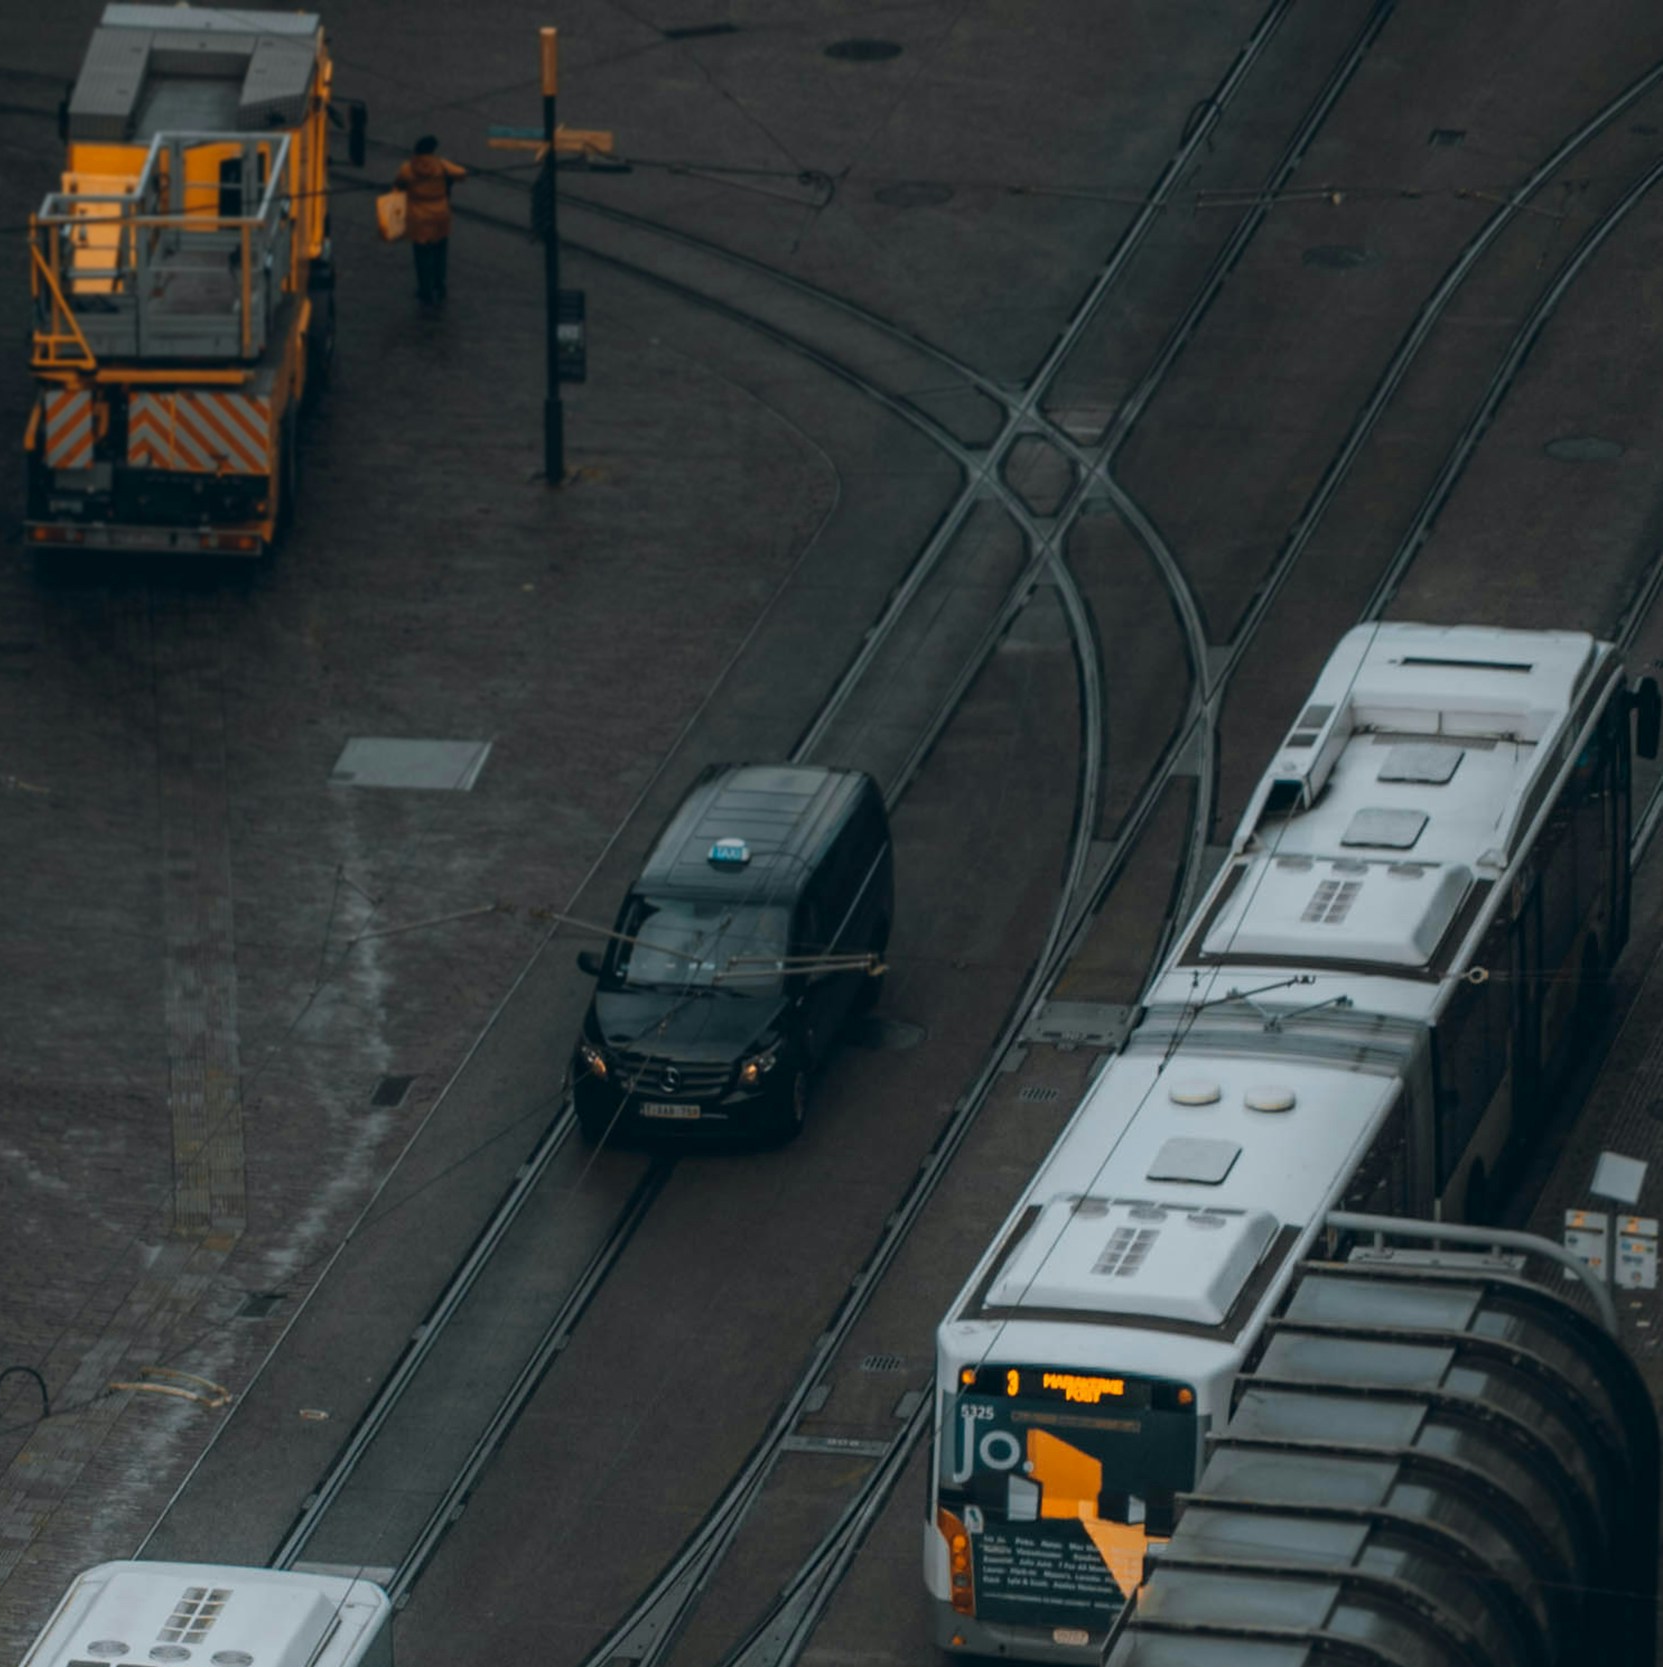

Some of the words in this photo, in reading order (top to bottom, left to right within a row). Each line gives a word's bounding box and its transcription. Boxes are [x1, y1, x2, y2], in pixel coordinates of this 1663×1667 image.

[717, 846, 742, 860] TAXI
[1007, 1369, 1020, 1397] 3
[961, 1404, 994, 1421] 5325
